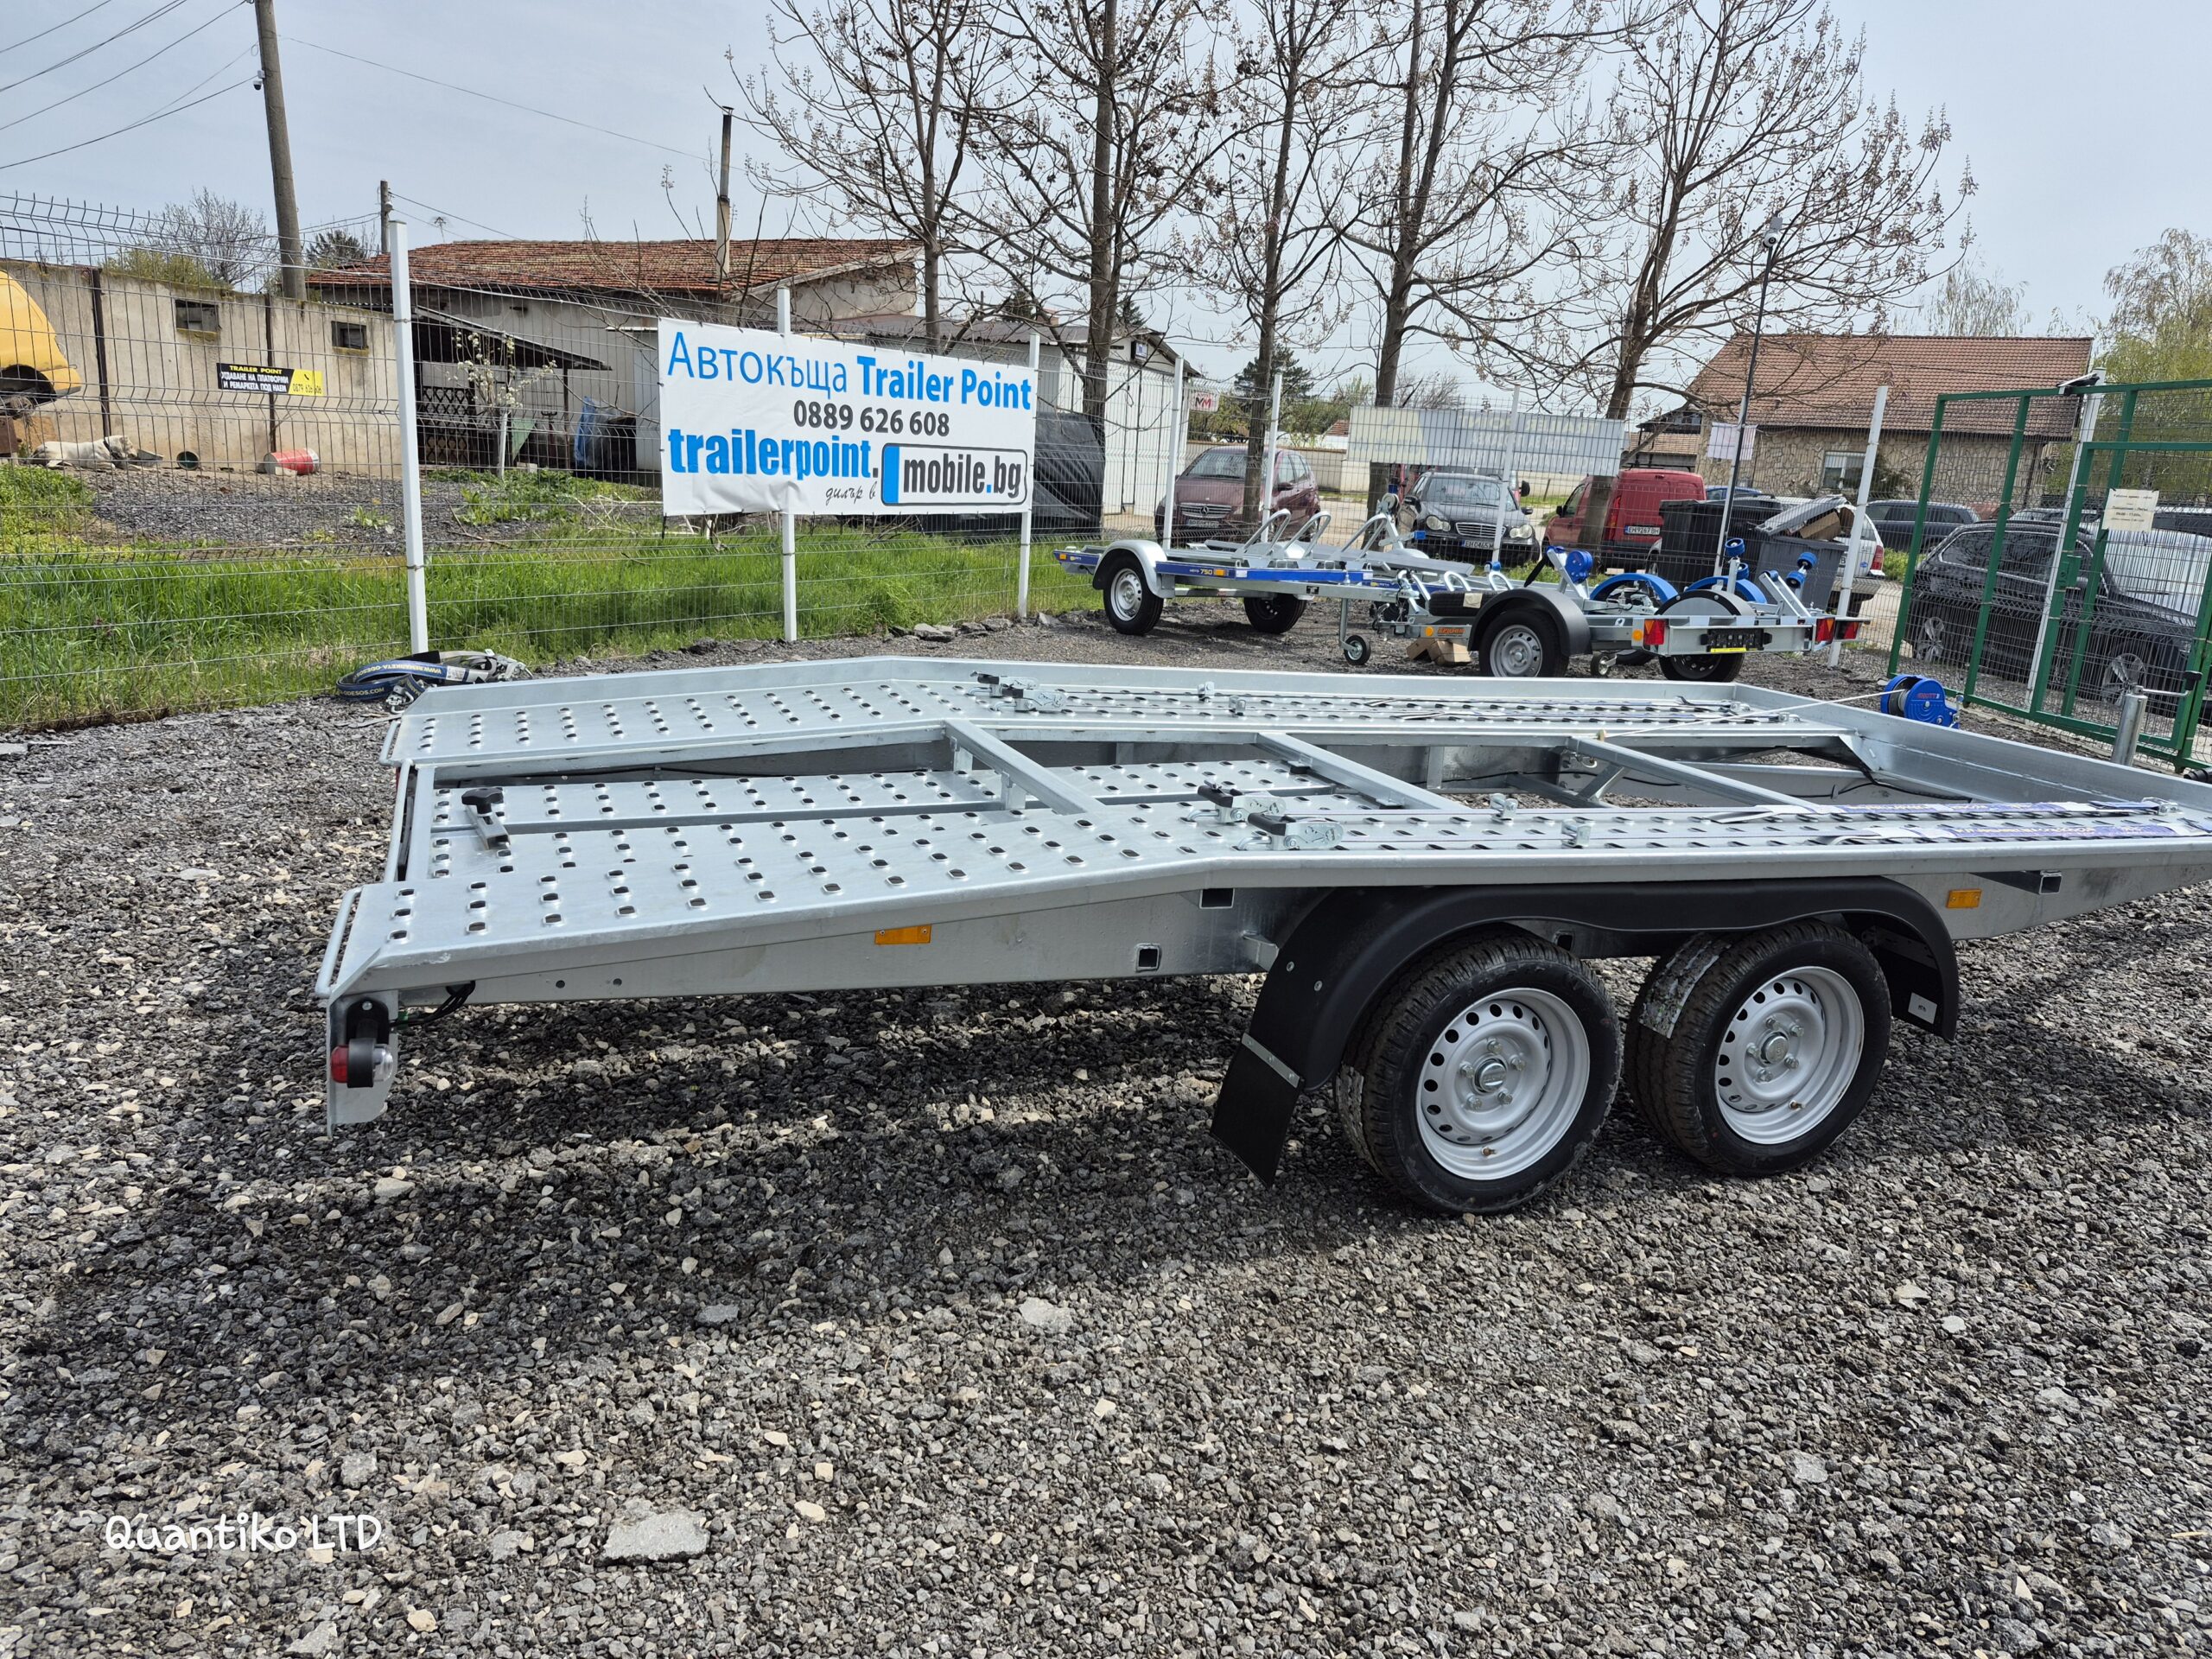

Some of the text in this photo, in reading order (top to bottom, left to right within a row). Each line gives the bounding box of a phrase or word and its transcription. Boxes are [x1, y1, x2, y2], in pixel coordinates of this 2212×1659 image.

[229, 365, 258, 373] TRAILER
[230, 381, 258, 391] РЕМАРКЕТА
[667, 331, 1032, 410] Автокъща Trailer Point
[793, 399, 950, 437] 0889 626 608
[903, 454, 1021, 499] mobile.bg
